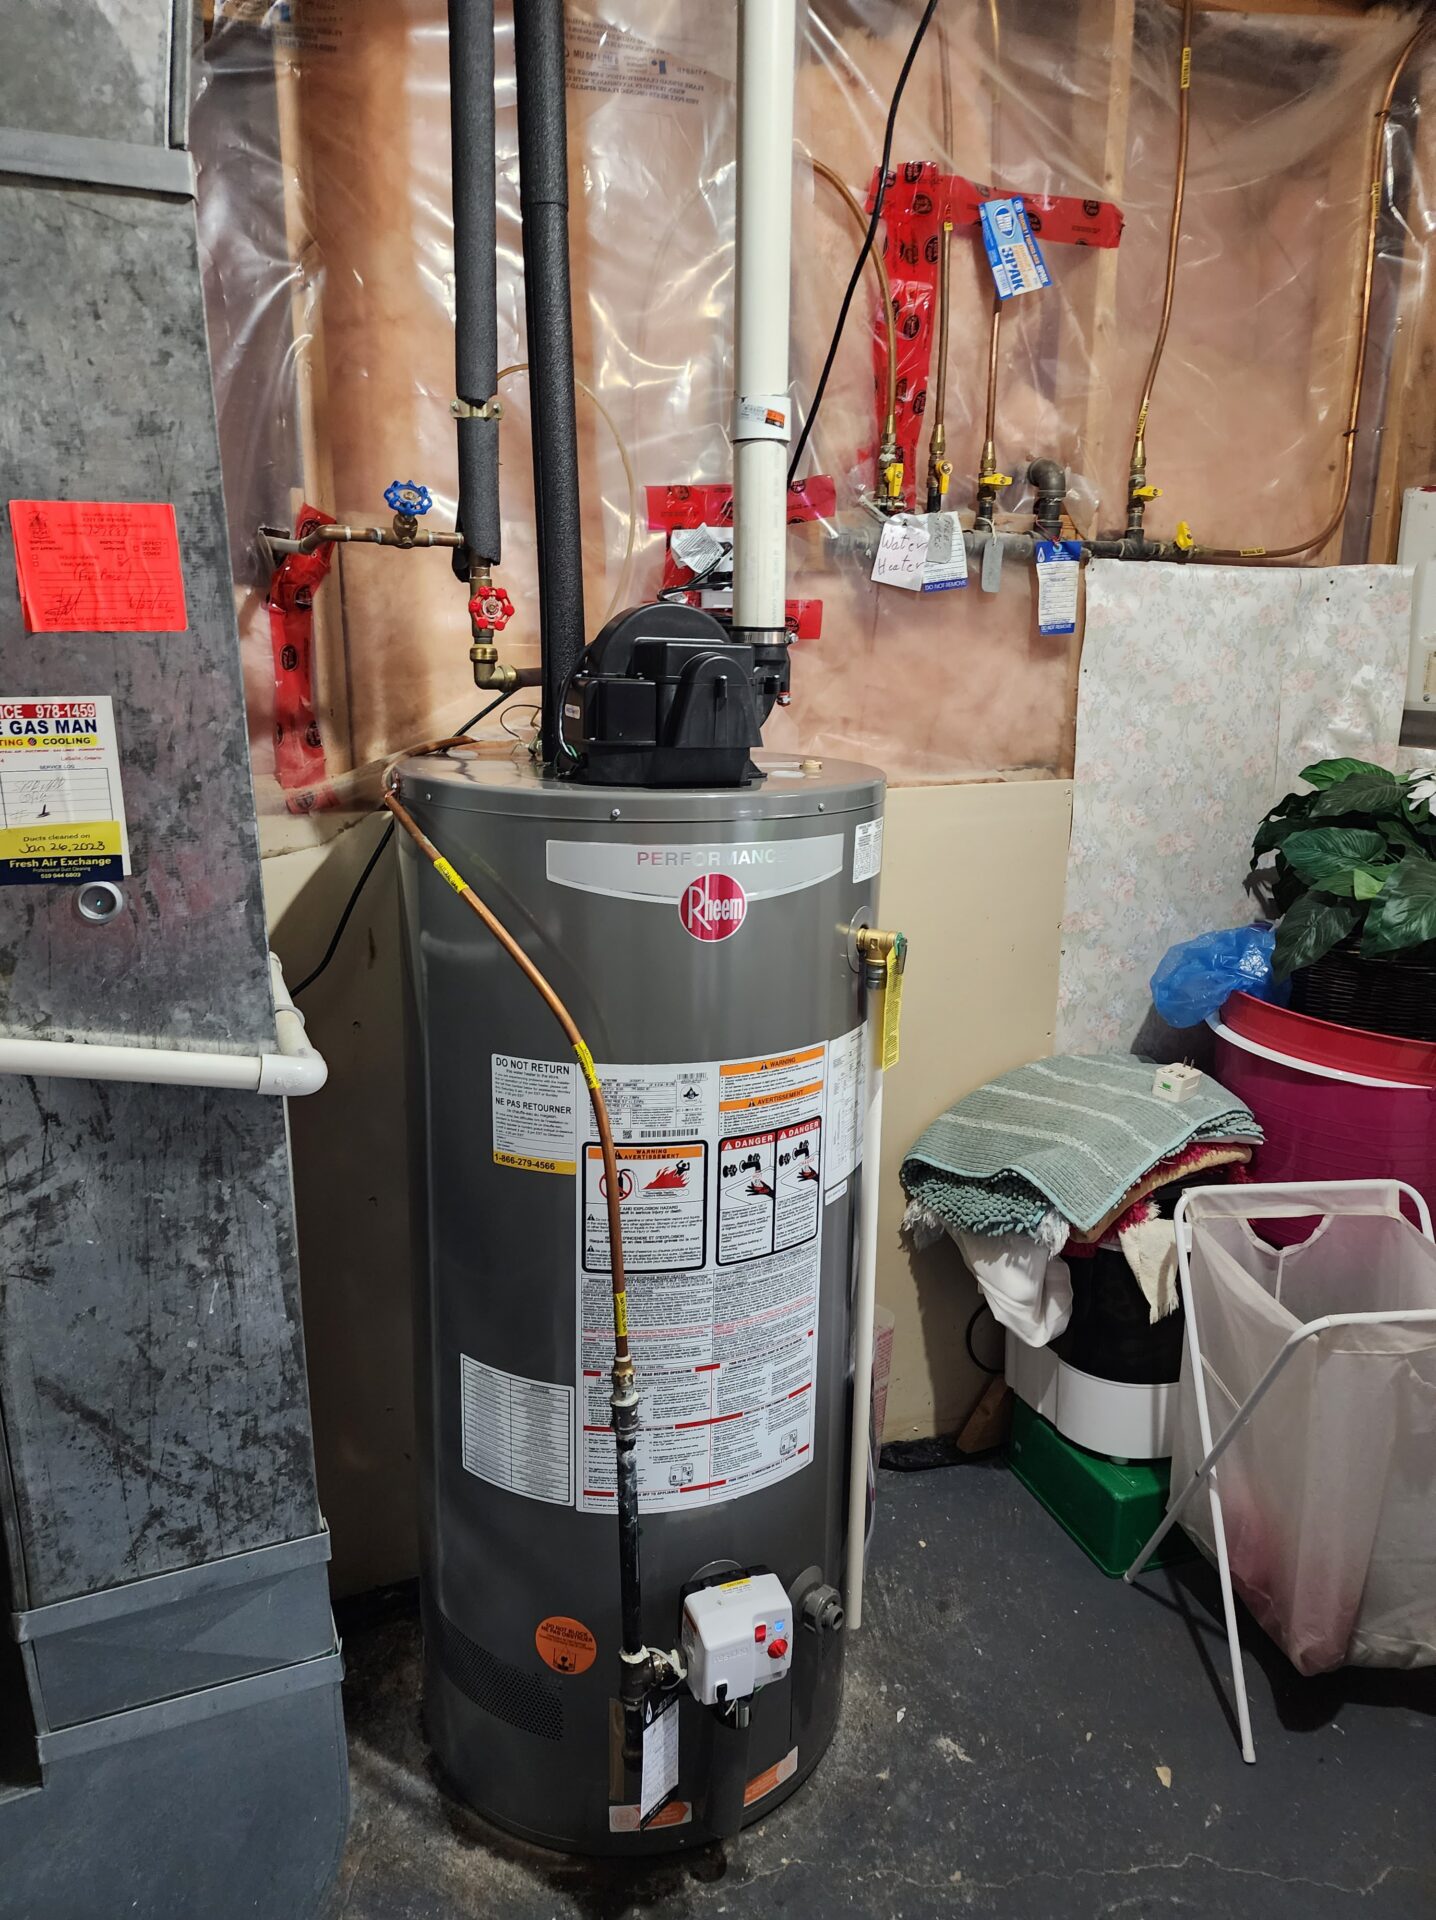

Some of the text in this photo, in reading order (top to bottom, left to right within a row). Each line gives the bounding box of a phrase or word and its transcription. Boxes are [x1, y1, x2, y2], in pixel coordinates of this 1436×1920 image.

[1001, 247, 1025, 291] 3PAK
[881, 534, 928, 552] Water
[878, 556, 925, 576] Heater
[934, 582, 946, 590] NOT
[946, 579, 967, 588] REMOVE
[35, 703, 96, 718] 978-1459
[9, 720, 49, 735] GAS
[55, 719, 97, 734] MAN
[42, 737, 91, 746] COOLING
[23, 835, 46, 843] Ducts
[48, 833, 79, 841] cleaned
[18, 843, 46, 854] Jan
[9, 857, 112, 868] Fresh Air Exchange
[687, 874, 743, 930] Rheem
[496, 1057, 570, 1075] DO NOT RETURN
[770, 1058, 795, 1067] WARNING
[757, 1090, 803, 1105] AVERTISSEMENT
[496, 1097, 571, 1114] NE PAS RETOURNER
[789, 1121, 819, 1137] DANGER
[735, 1135, 773, 1148] DANGER
[495, 1154, 555, 1170] 1-866-279-4566
